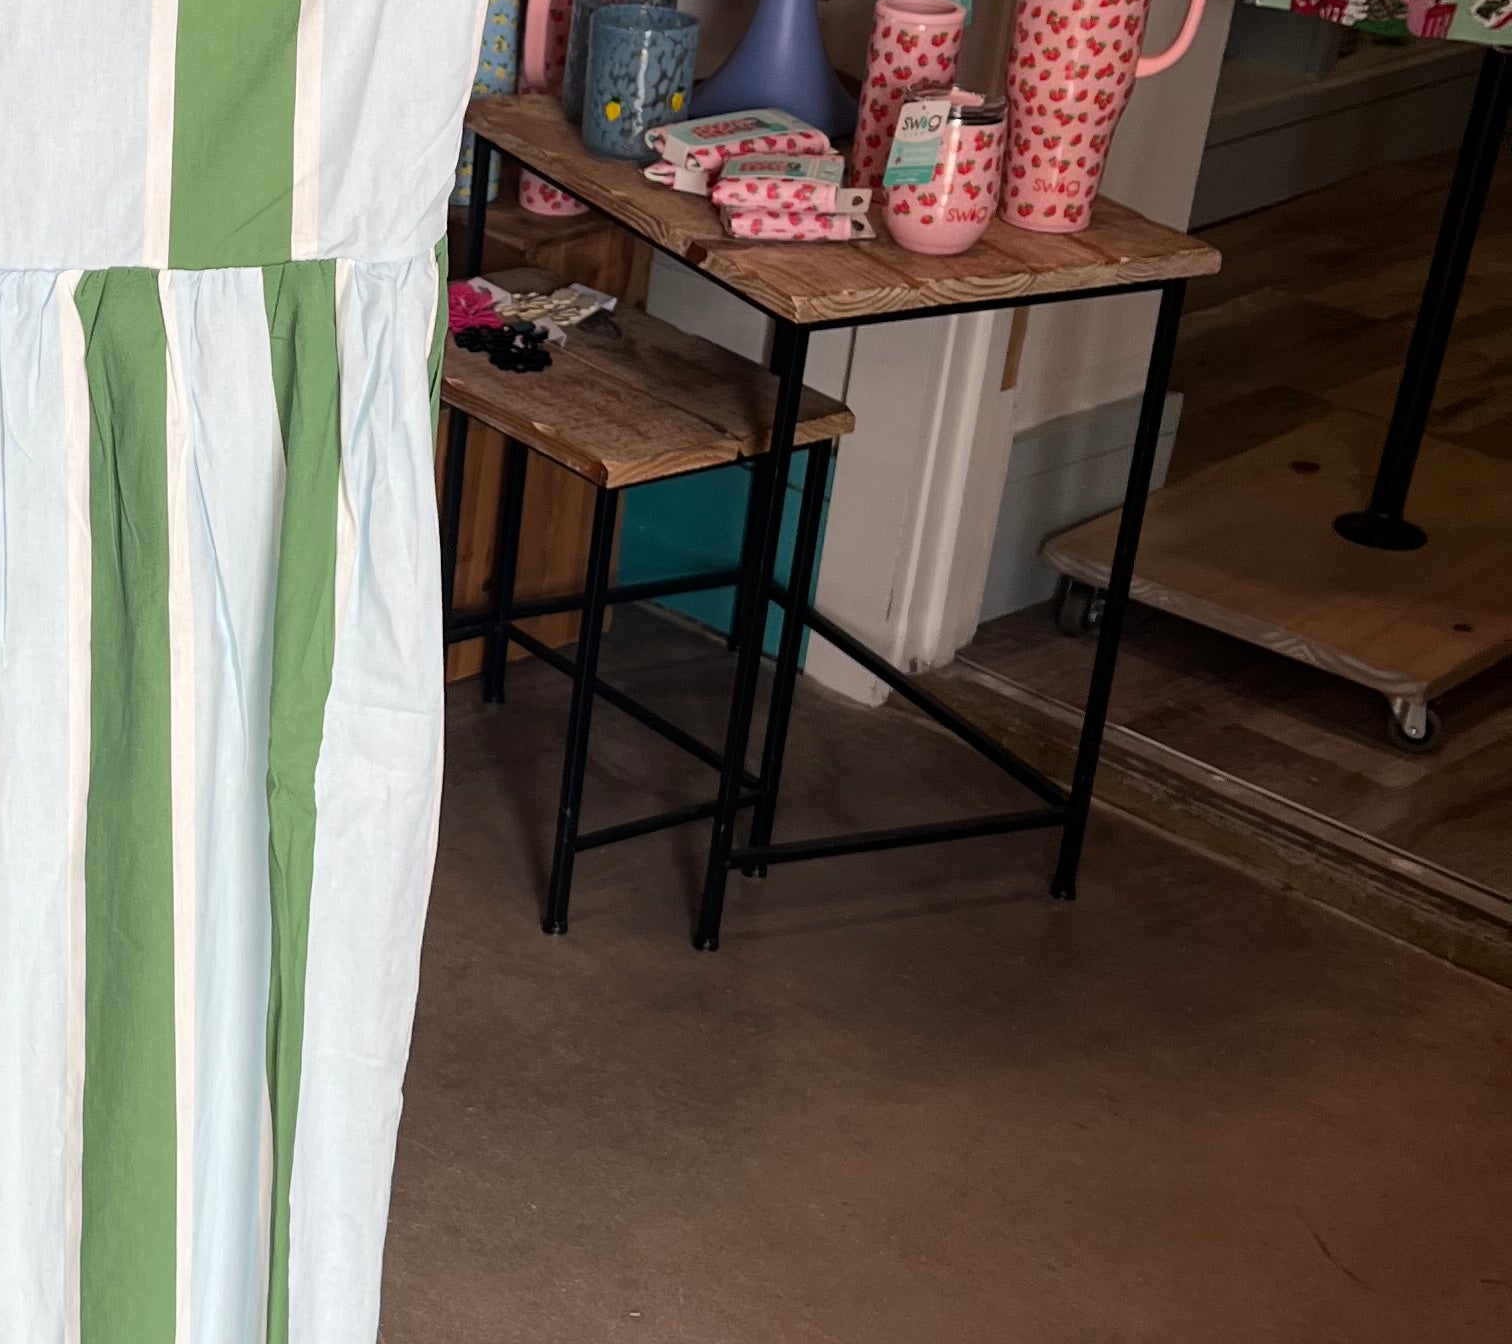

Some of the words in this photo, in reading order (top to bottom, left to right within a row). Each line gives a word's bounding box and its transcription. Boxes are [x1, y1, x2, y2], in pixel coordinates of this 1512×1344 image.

[901, 112, 943, 132] swig
[1032, 176, 1081, 197] swig
[945, 204, 988, 224] swig
